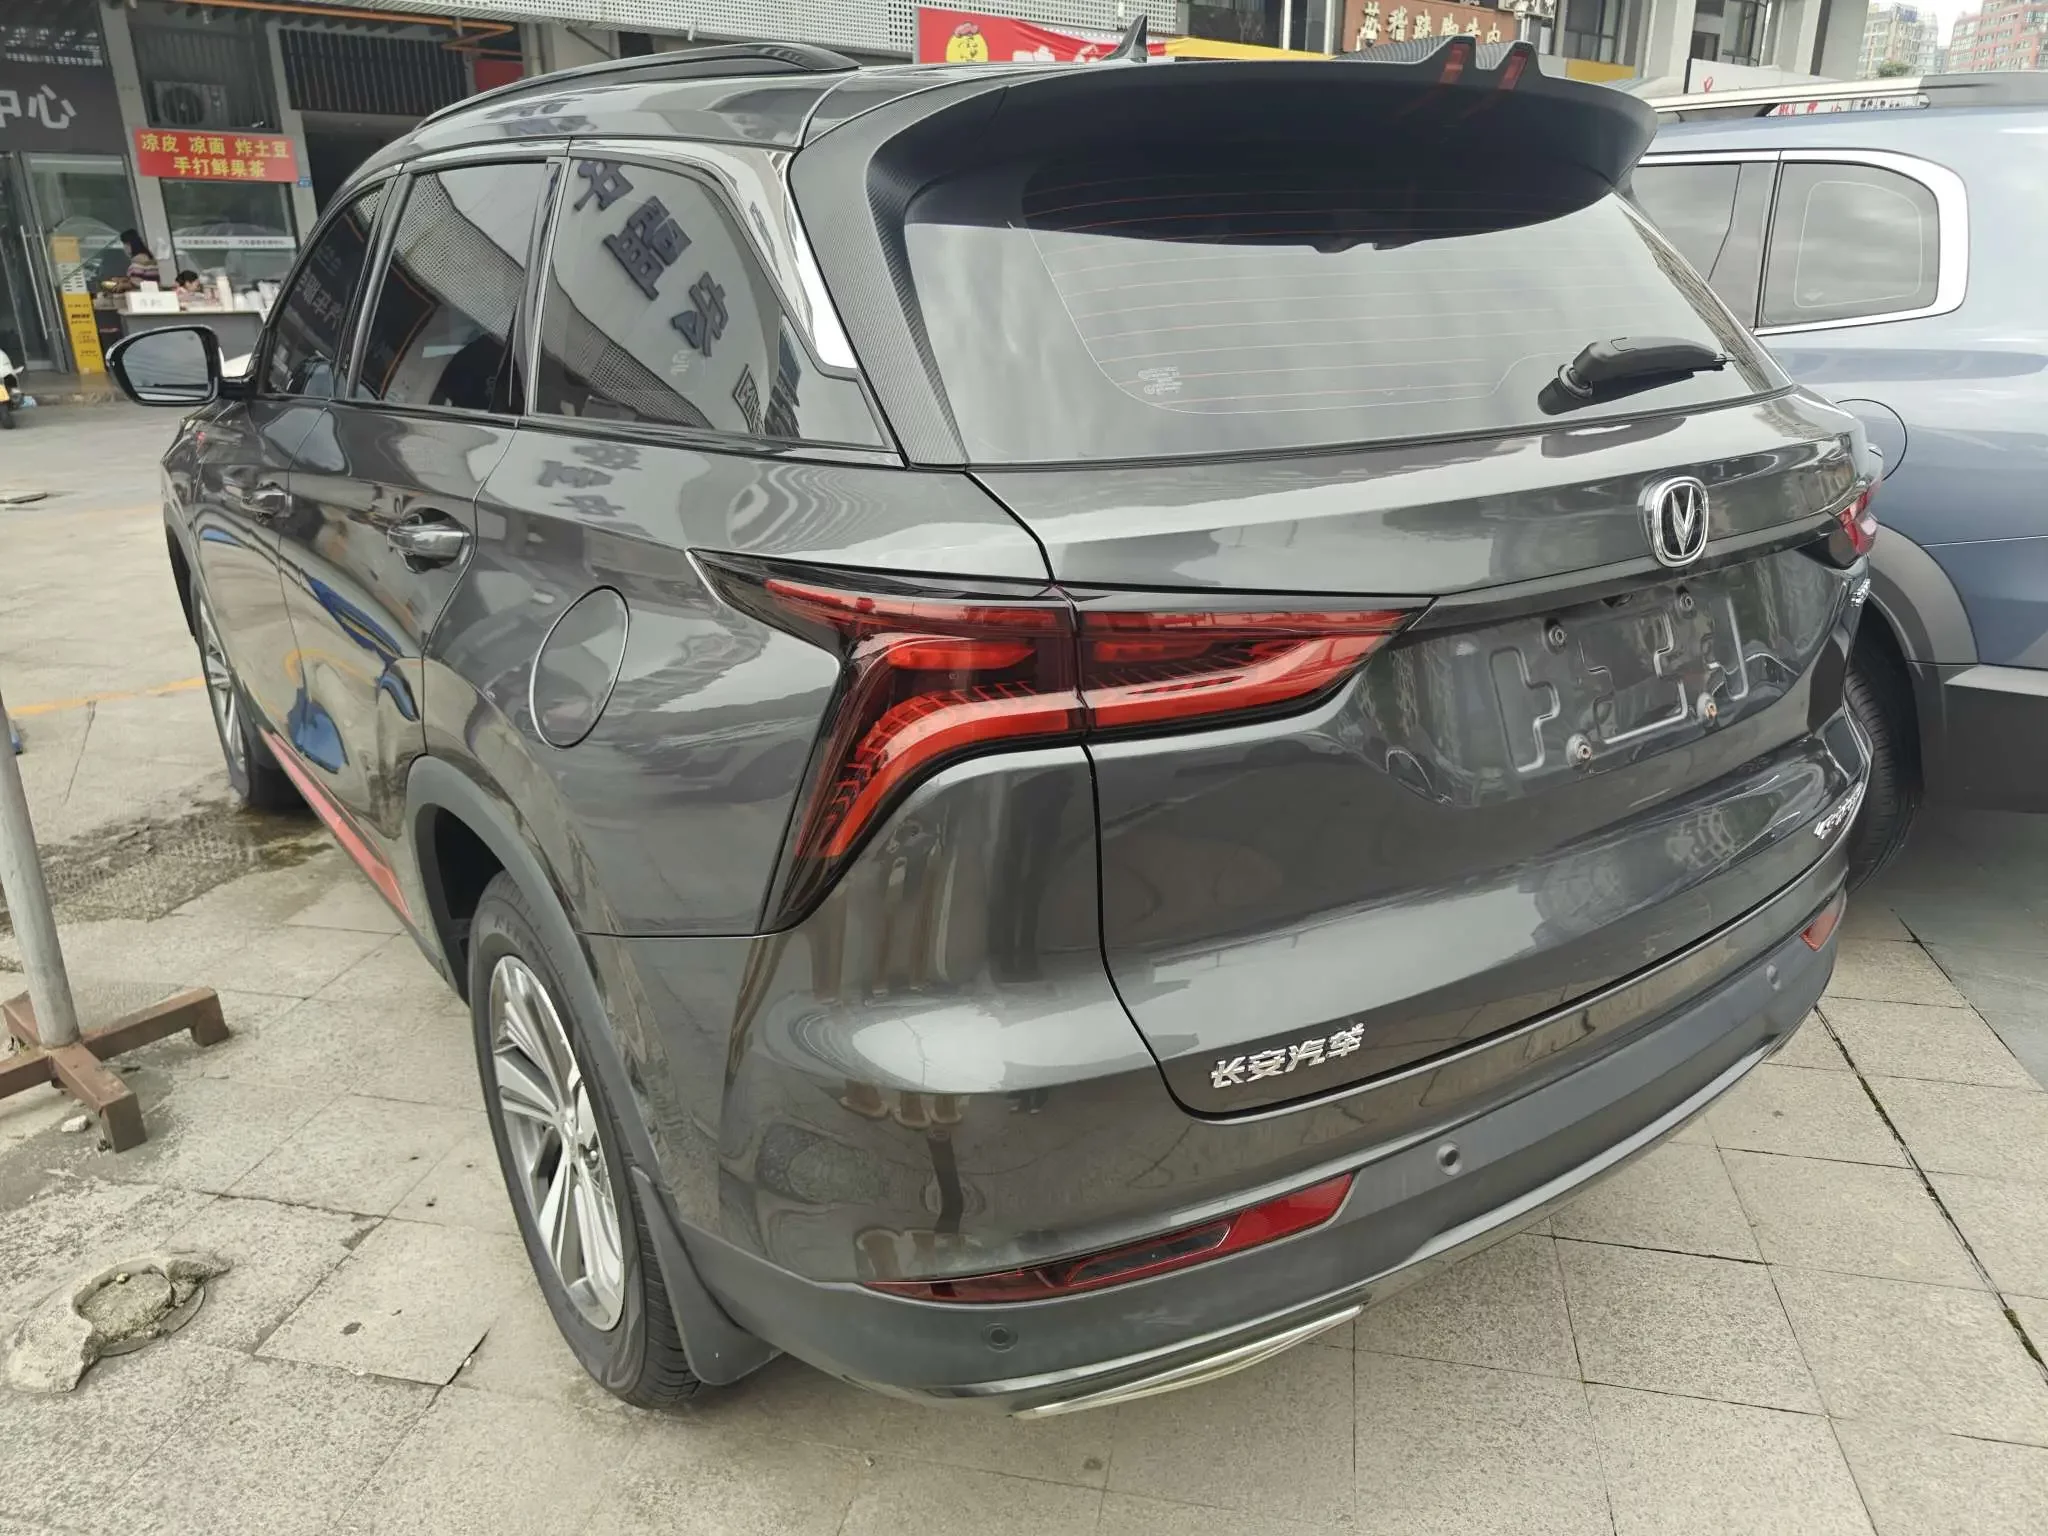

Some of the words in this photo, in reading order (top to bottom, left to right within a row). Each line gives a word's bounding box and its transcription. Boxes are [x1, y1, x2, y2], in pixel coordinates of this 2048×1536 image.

[140, 133, 180, 153] 凉皮
[188, 136, 226, 156] 凉面
[234, 138, 290, 159] 炸土豆
[173, 156, 266, 178] 手打鲜果茶
